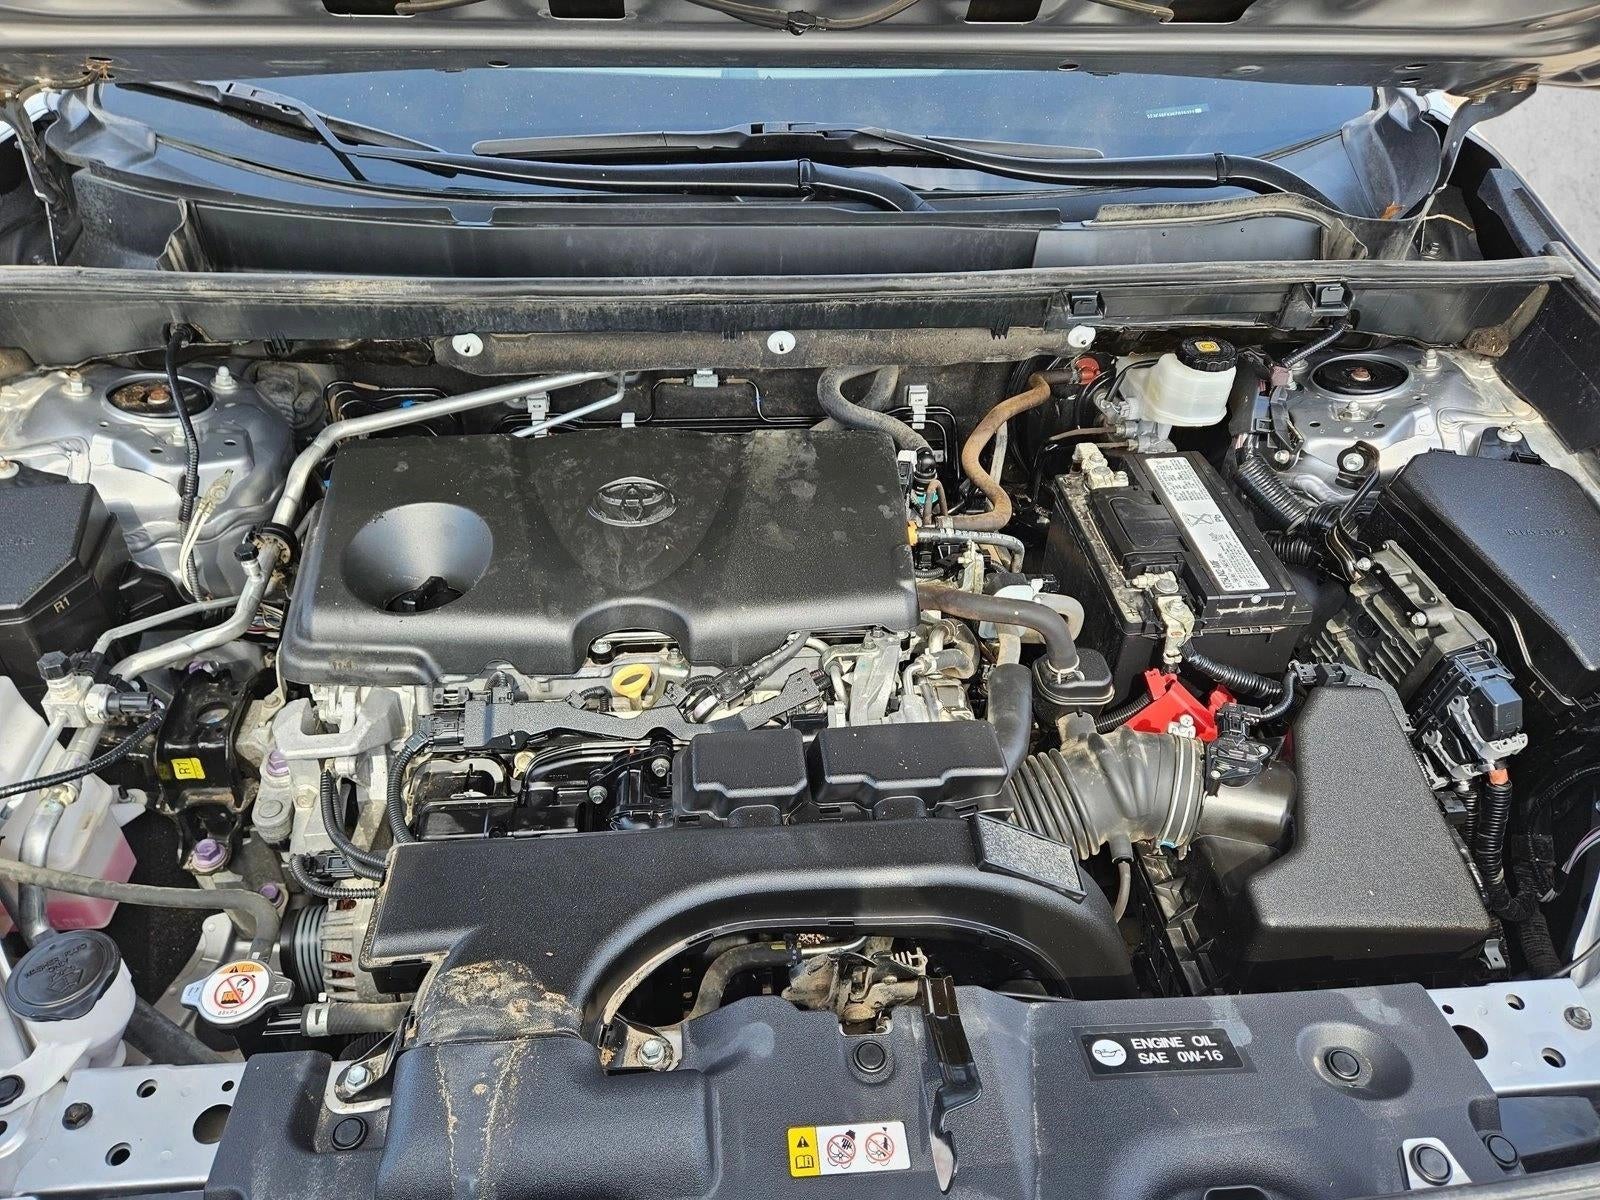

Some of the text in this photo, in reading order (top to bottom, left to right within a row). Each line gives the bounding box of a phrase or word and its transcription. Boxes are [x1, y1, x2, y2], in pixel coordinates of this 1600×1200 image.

[53, 596, 70, 613] R1
[1529, 681, 1545, 699] L1
[1131, 1035, 1217, 1049] ENGINE OIL
[1138, 1049, 1224, 1065] SAE 0W-16
